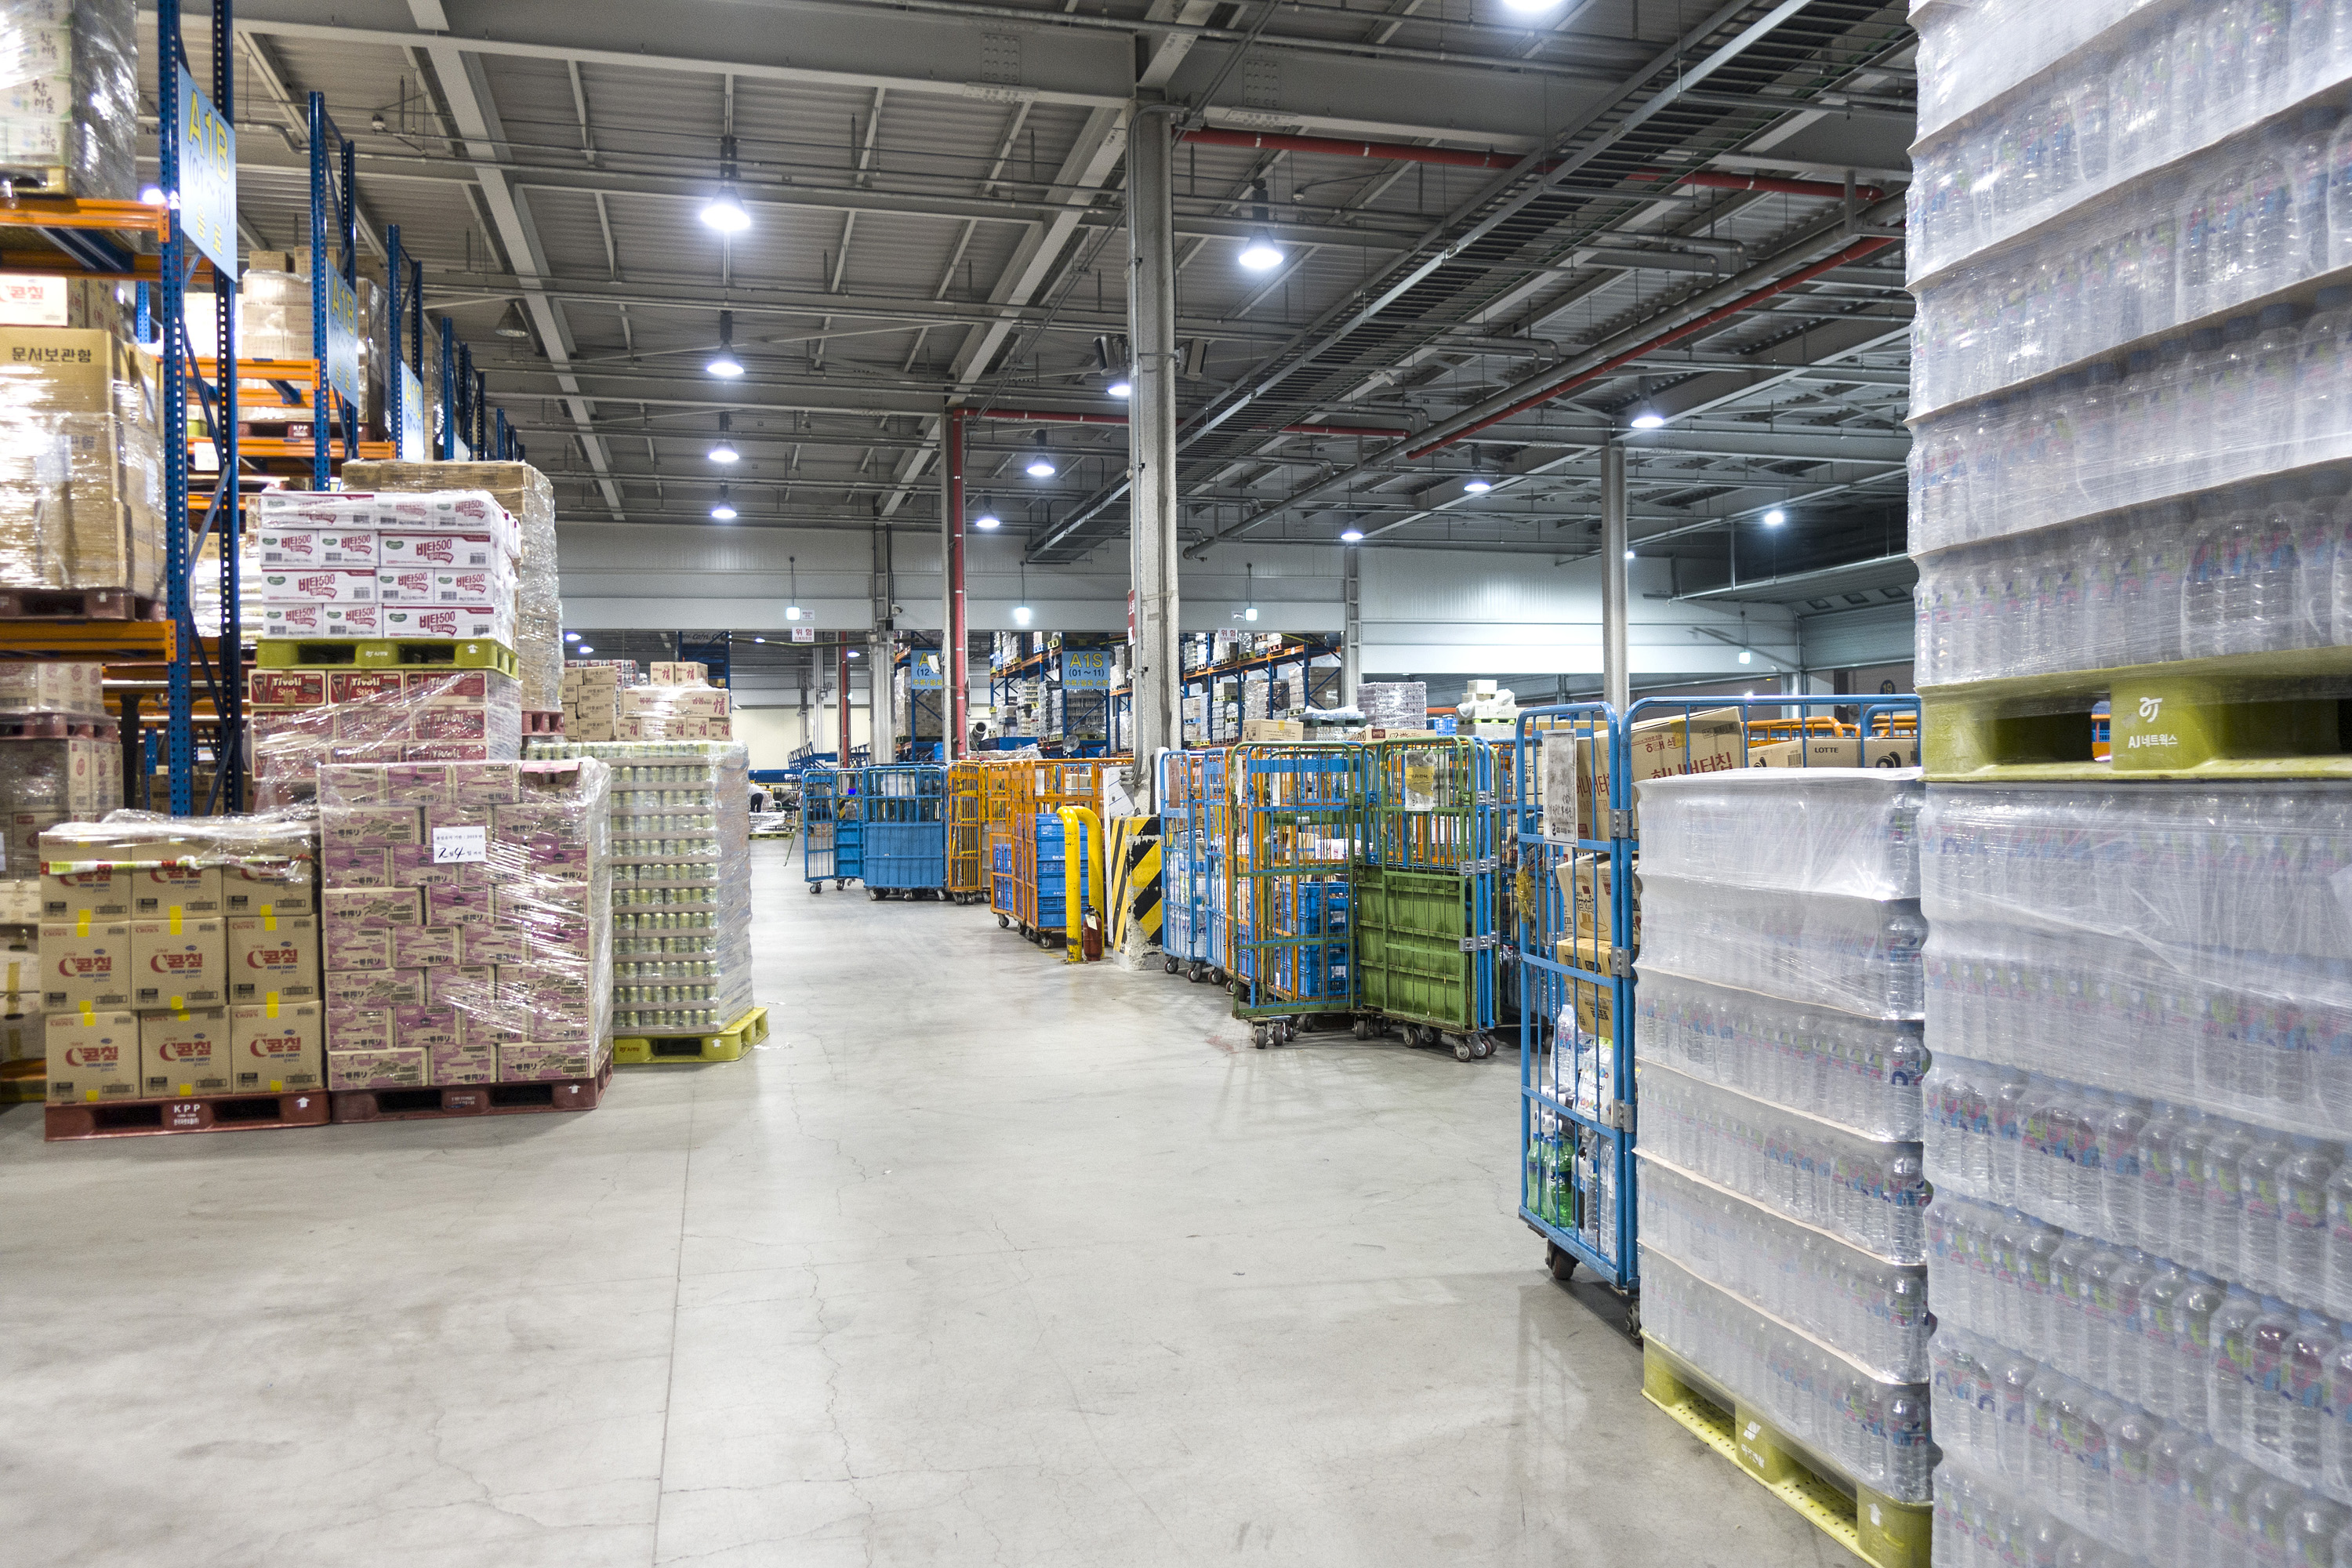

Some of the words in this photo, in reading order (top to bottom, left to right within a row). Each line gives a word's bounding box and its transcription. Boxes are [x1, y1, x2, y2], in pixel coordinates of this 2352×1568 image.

[188, 92, 229, 183] A1B
[332, 276, 354, 336] A1B
[12, 347, 92, 363] 문서보관함
[416, 539, 452, 557] 비타500
[298, 574, 336, 592] 비타500
[398, 572, 427, 586] 비타500
[456, 574, 485, 587] 비타500
[346, 607, 375, 622] 비타500
[419, 611, 456, 629] 비타500
[1069, 653, 1103, 668] A1S
[1069, 669, 1081, 677] (01
[1094, 669, 1105, 677] 11)
[273, 677, 302, 686] Tivoli
[352, 677, 380, 686] Tivoli
[1882, 683, 1893, 694] 19
[278, 688, 298, 696] Stick
[356, 688, 376, 696] Stick
[2128, 734, 2178, 749] AJ네트웍스
[438, 847, 448, 858] 2
[454, 847, 466, 860] 4
[76, 956, 112, 972] 콘칩
[166, 953, 203, 968] 콘칩
[263, 949, 298, 964] 콘칩
[176, 1040, 211, 1057] 콘칩
[267, 1036, 301, 1053] 콘칩
[83, 1046, 118, 1062] 콘칩
[173, 1104, 201, 1113] KPP
